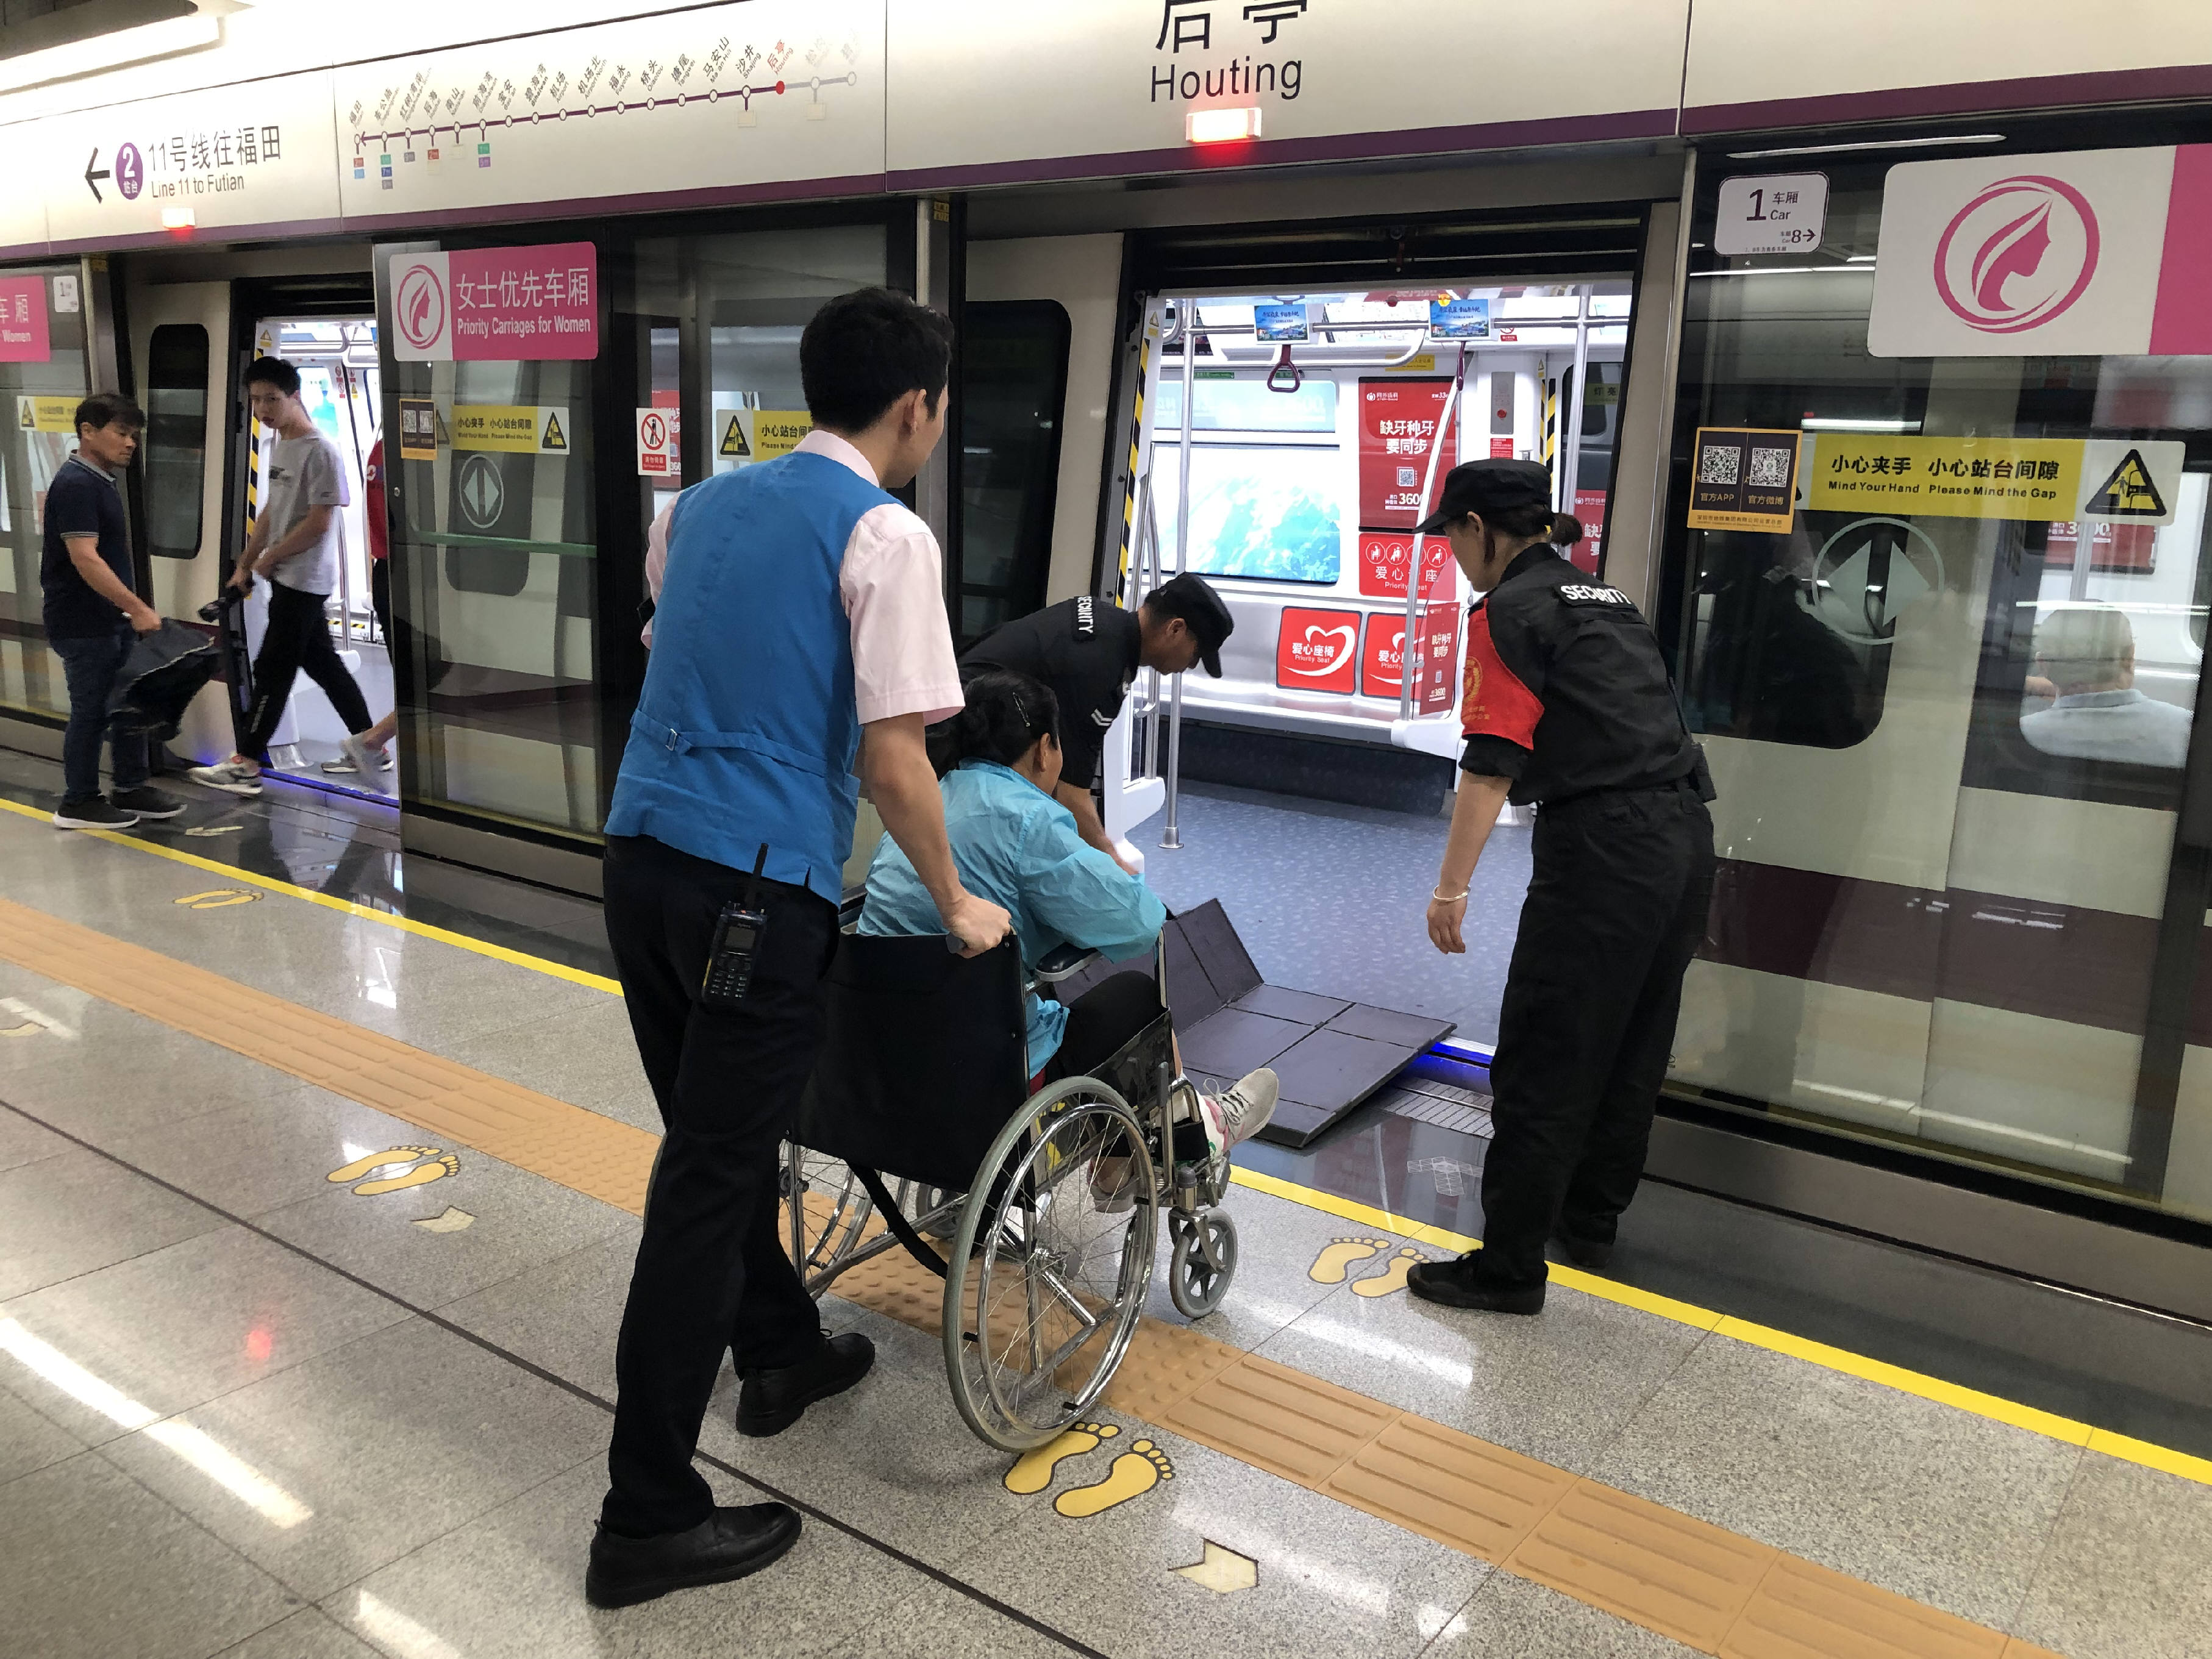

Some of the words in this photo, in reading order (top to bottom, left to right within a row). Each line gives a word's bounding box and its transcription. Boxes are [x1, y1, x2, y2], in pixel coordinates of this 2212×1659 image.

[703, 37, 729, 77] 马安山
[735, 45, 754, 73] 沙井
[743, 52, 761, 79] Shajing
[550, 71, 566, 98] 机场
[578, 55, 601, 94] 机场北
[1151, 56, 1302, 102] Houting
[149, 126, 280, 171] 11号线往福田
[123, 146, 135, 178] 2
[152, 180, 176, 198] Line
[179, 178, 189, 194] 11
[193, 177, 204, 193] to
[207, 173, 244, 193] Futian
[1746, 189, 1767, 221] 1
[1772, 191, 1799, 204] 车厢
[1771, 209, 1791, 220] Car
[1791, 229, 1802, 243] 8
[456, 268, 589, 310] 女士优先车厢
[458, 317, 489, 339] Priority
[492, 316, 535, 338] Carriages
[538, 315, 552, 334] for
[554, 315, 590, 334] Women
[761, 424, 812, 438] 小心站台间
[1380, 419, 1435, 438] 缺牙种牙
[1386, 438, 1428, 454] 要同步
[1832, 455, 1912, 475] 小心夹手
[1928, 458, 2060, 480] 小心站台间隙
[1700, 493, 1735, 502] 官方APP
[1748, 494, 1784, 505] 官方微博
[1829, 481, 1856, 490] Mind
[1860, 482, 1886, 491] Your
[1889, 483, 1919, 493] Hand
[1929, 484, 1970, 495] Please
[1974, 487, 2004, 496] Mind
[2008, 488, 2027, 498] the
[2031, 488, 2057, 499] Gap
[1375, 566, 1438, 582] 爱心座
[1385, 581, 1408, 591] Priority
[1561, 585, 1632, 604] SECURITY
[1077, 596, 1094, 633] SECURITY
[1292, 643, 1335, 657] 爱心座椅
[1295, 654, 1315, 663] Priority
